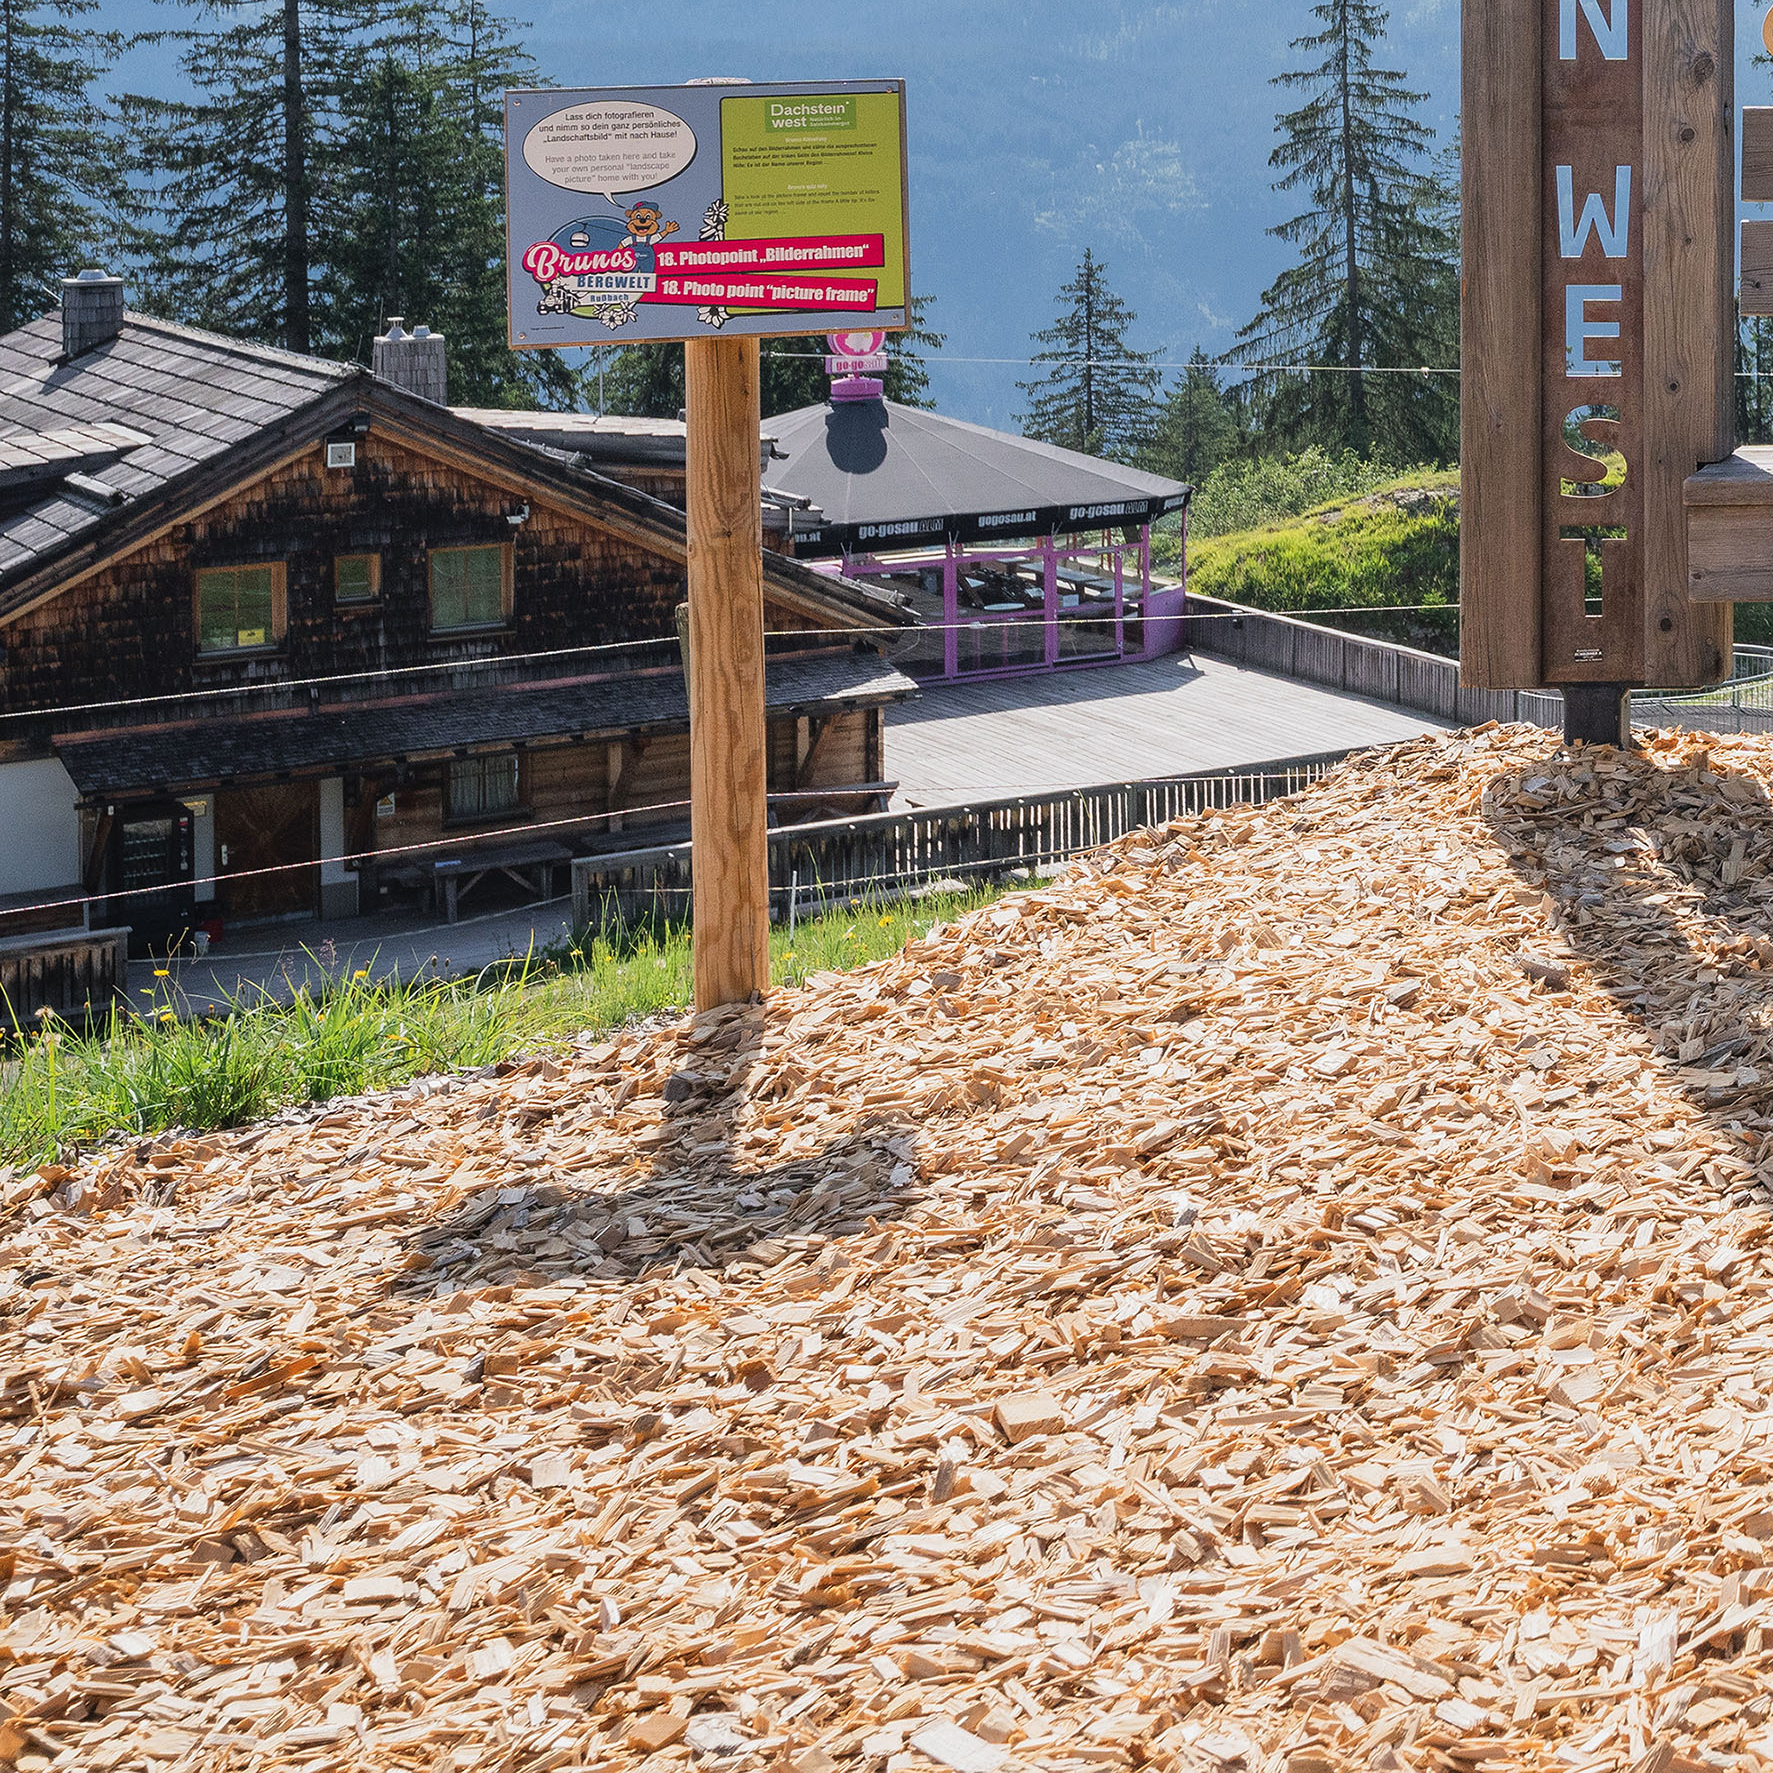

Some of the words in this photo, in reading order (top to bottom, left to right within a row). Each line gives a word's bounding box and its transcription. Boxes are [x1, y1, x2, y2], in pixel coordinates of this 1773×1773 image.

[565, 113, 583, 121] Lass
[585, 112, 602, 120] dich
[604, 110, 654, 120] fotografieren
[770, 102, 846, 116] Dachstein
[539, 124, 554, 133] und
[555, 123, 579, 132] nimm
[580, 123, 590, 131] so
[592, 122, 610, 131] dein
[611, 123, 630, 133] ganz
[632, 120, 681, 132] persönliches
[771, 117, 807, 128] west
[614, 132, 628, 140] mit
[629, 131, 648, 139] nach
[651, 130, 678, 139] Hause!
[545, 155, 565, 163] Have
[574, 153, 597, 164] photo
[598, 153, 620, 161] taken
[622, 152, 640, 160] here
[659, 151, 676, 159] take
[552, 165, 570, 174] your
[590, 163, 624, 173] personal
[597, 173, 621, 182] home
[622, 173, 639, 181] with
[641, 172, 658, 182] you!
[526, 244, 636, 279] Brunos
[657, 252, 678, 267] 18.
[679, 248, 758, 266] Photopoint
[577, 276, 650, 289] BERGWELT
[662, 280, 681, 295] 18.
[683, 281, 724, 297] Photo
[727, 283, 764, 301] point
[1556, 165, 1630, 617] WEST
[978, 510, 1037, 527] gogosau.at
